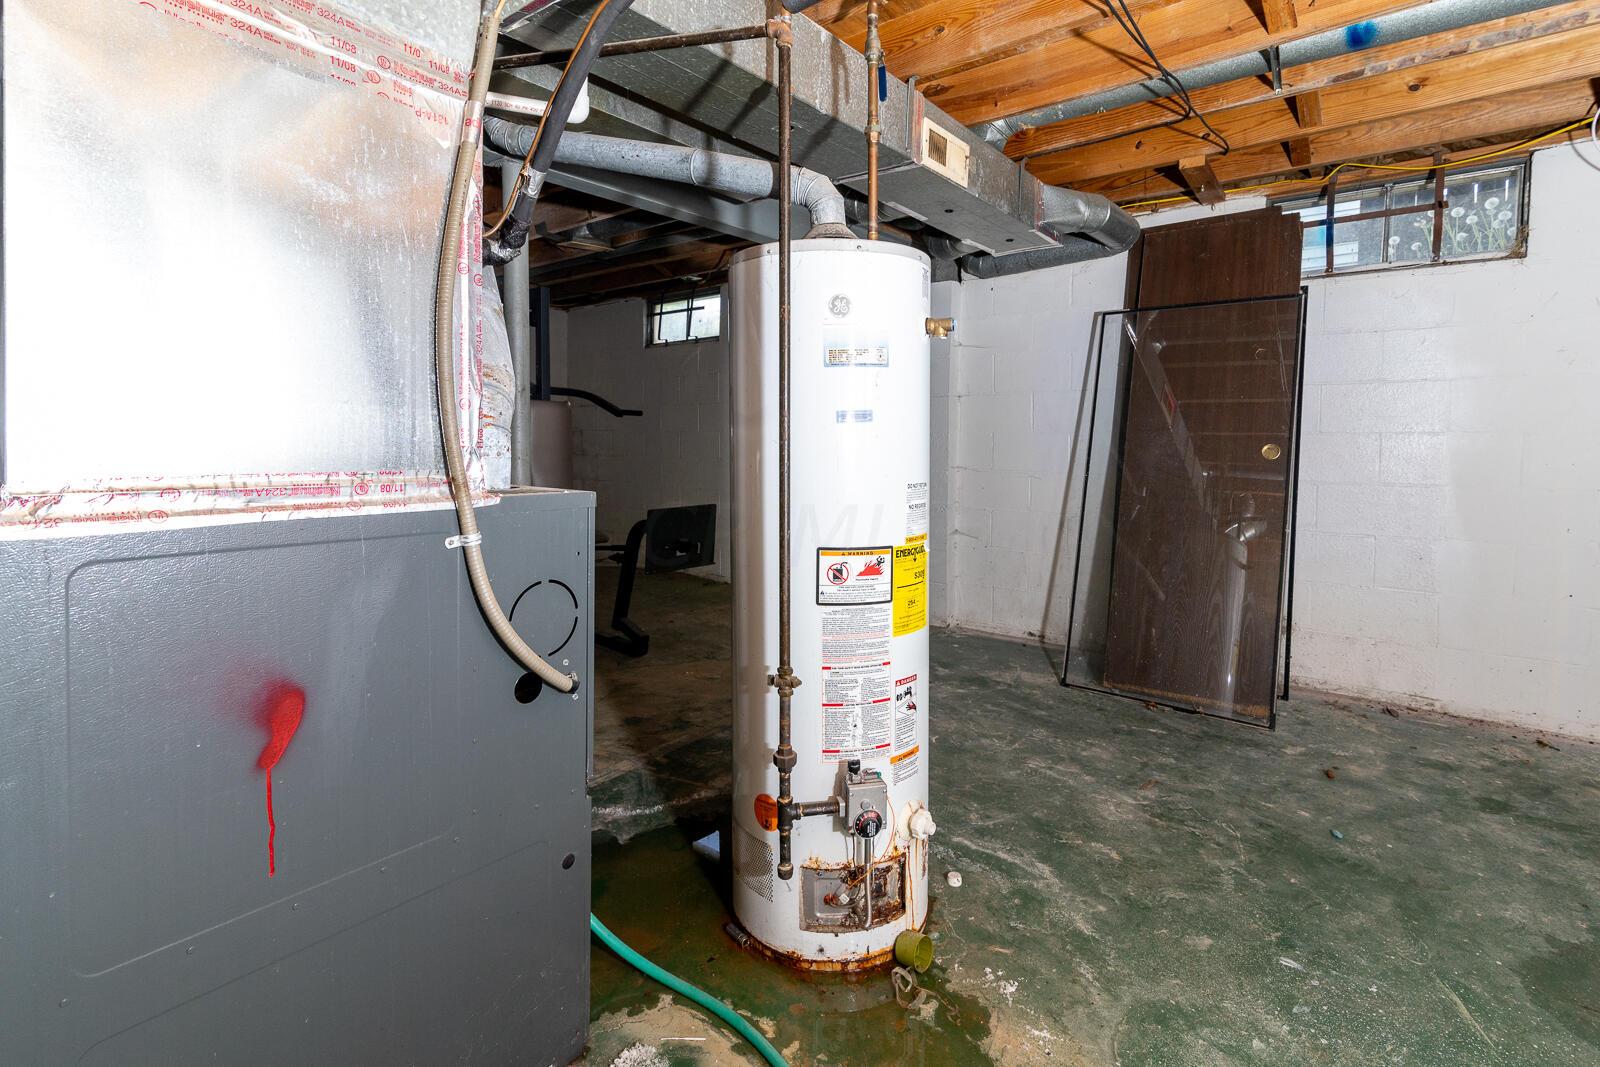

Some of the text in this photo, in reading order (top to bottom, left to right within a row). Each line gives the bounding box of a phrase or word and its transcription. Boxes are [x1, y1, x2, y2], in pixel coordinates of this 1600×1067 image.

[231, 0, 262, 18] 324A
[317, 7, 345, 27] 324A
[230, 17, 262, 38] 324A
[330, 35, 357, 54] 11/08
[329, 55, 357, 73] 11/08
[437, 81, 461, 97] 324A
[254, 487, 287, 497] 324A
[379, 484, 404, 494] 11/08
[900, 674, 916, 685] DANGER
